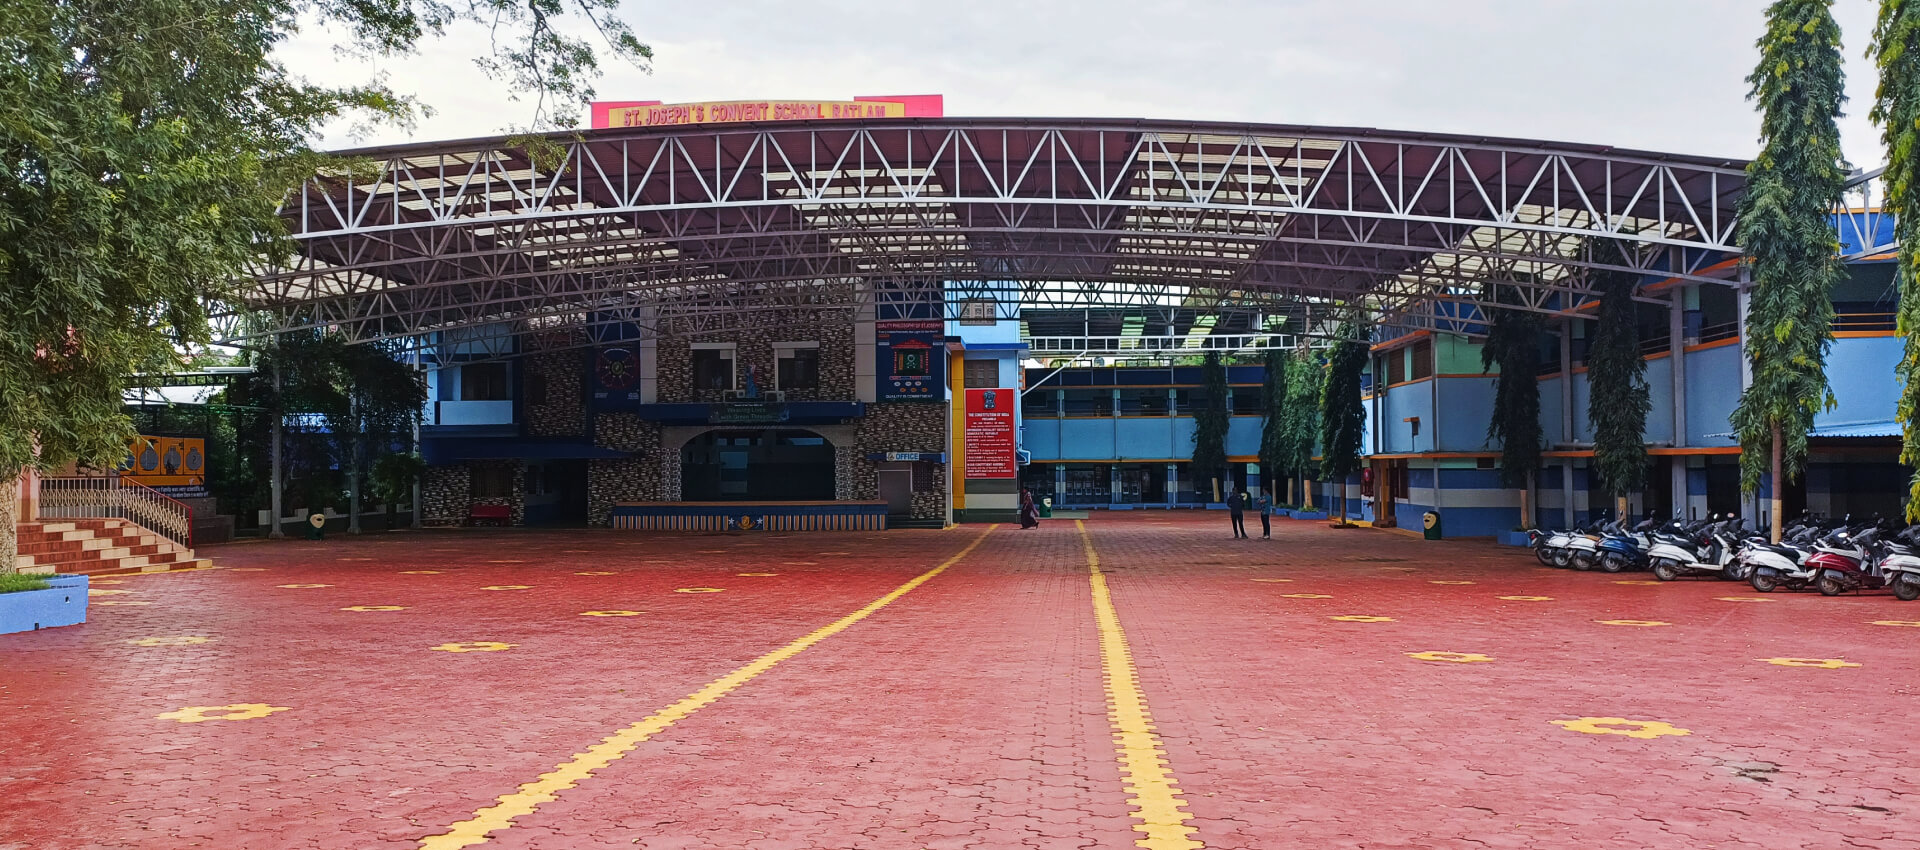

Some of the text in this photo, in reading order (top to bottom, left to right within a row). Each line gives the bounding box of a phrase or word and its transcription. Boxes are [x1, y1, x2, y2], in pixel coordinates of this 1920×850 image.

[624, 110, 641, 127] ST.
[646, 104, 704, 126] JOSEPH'S
[710, 102, 769, 122] CONVENT
[773, 103, 825, 120] SCHOOL
